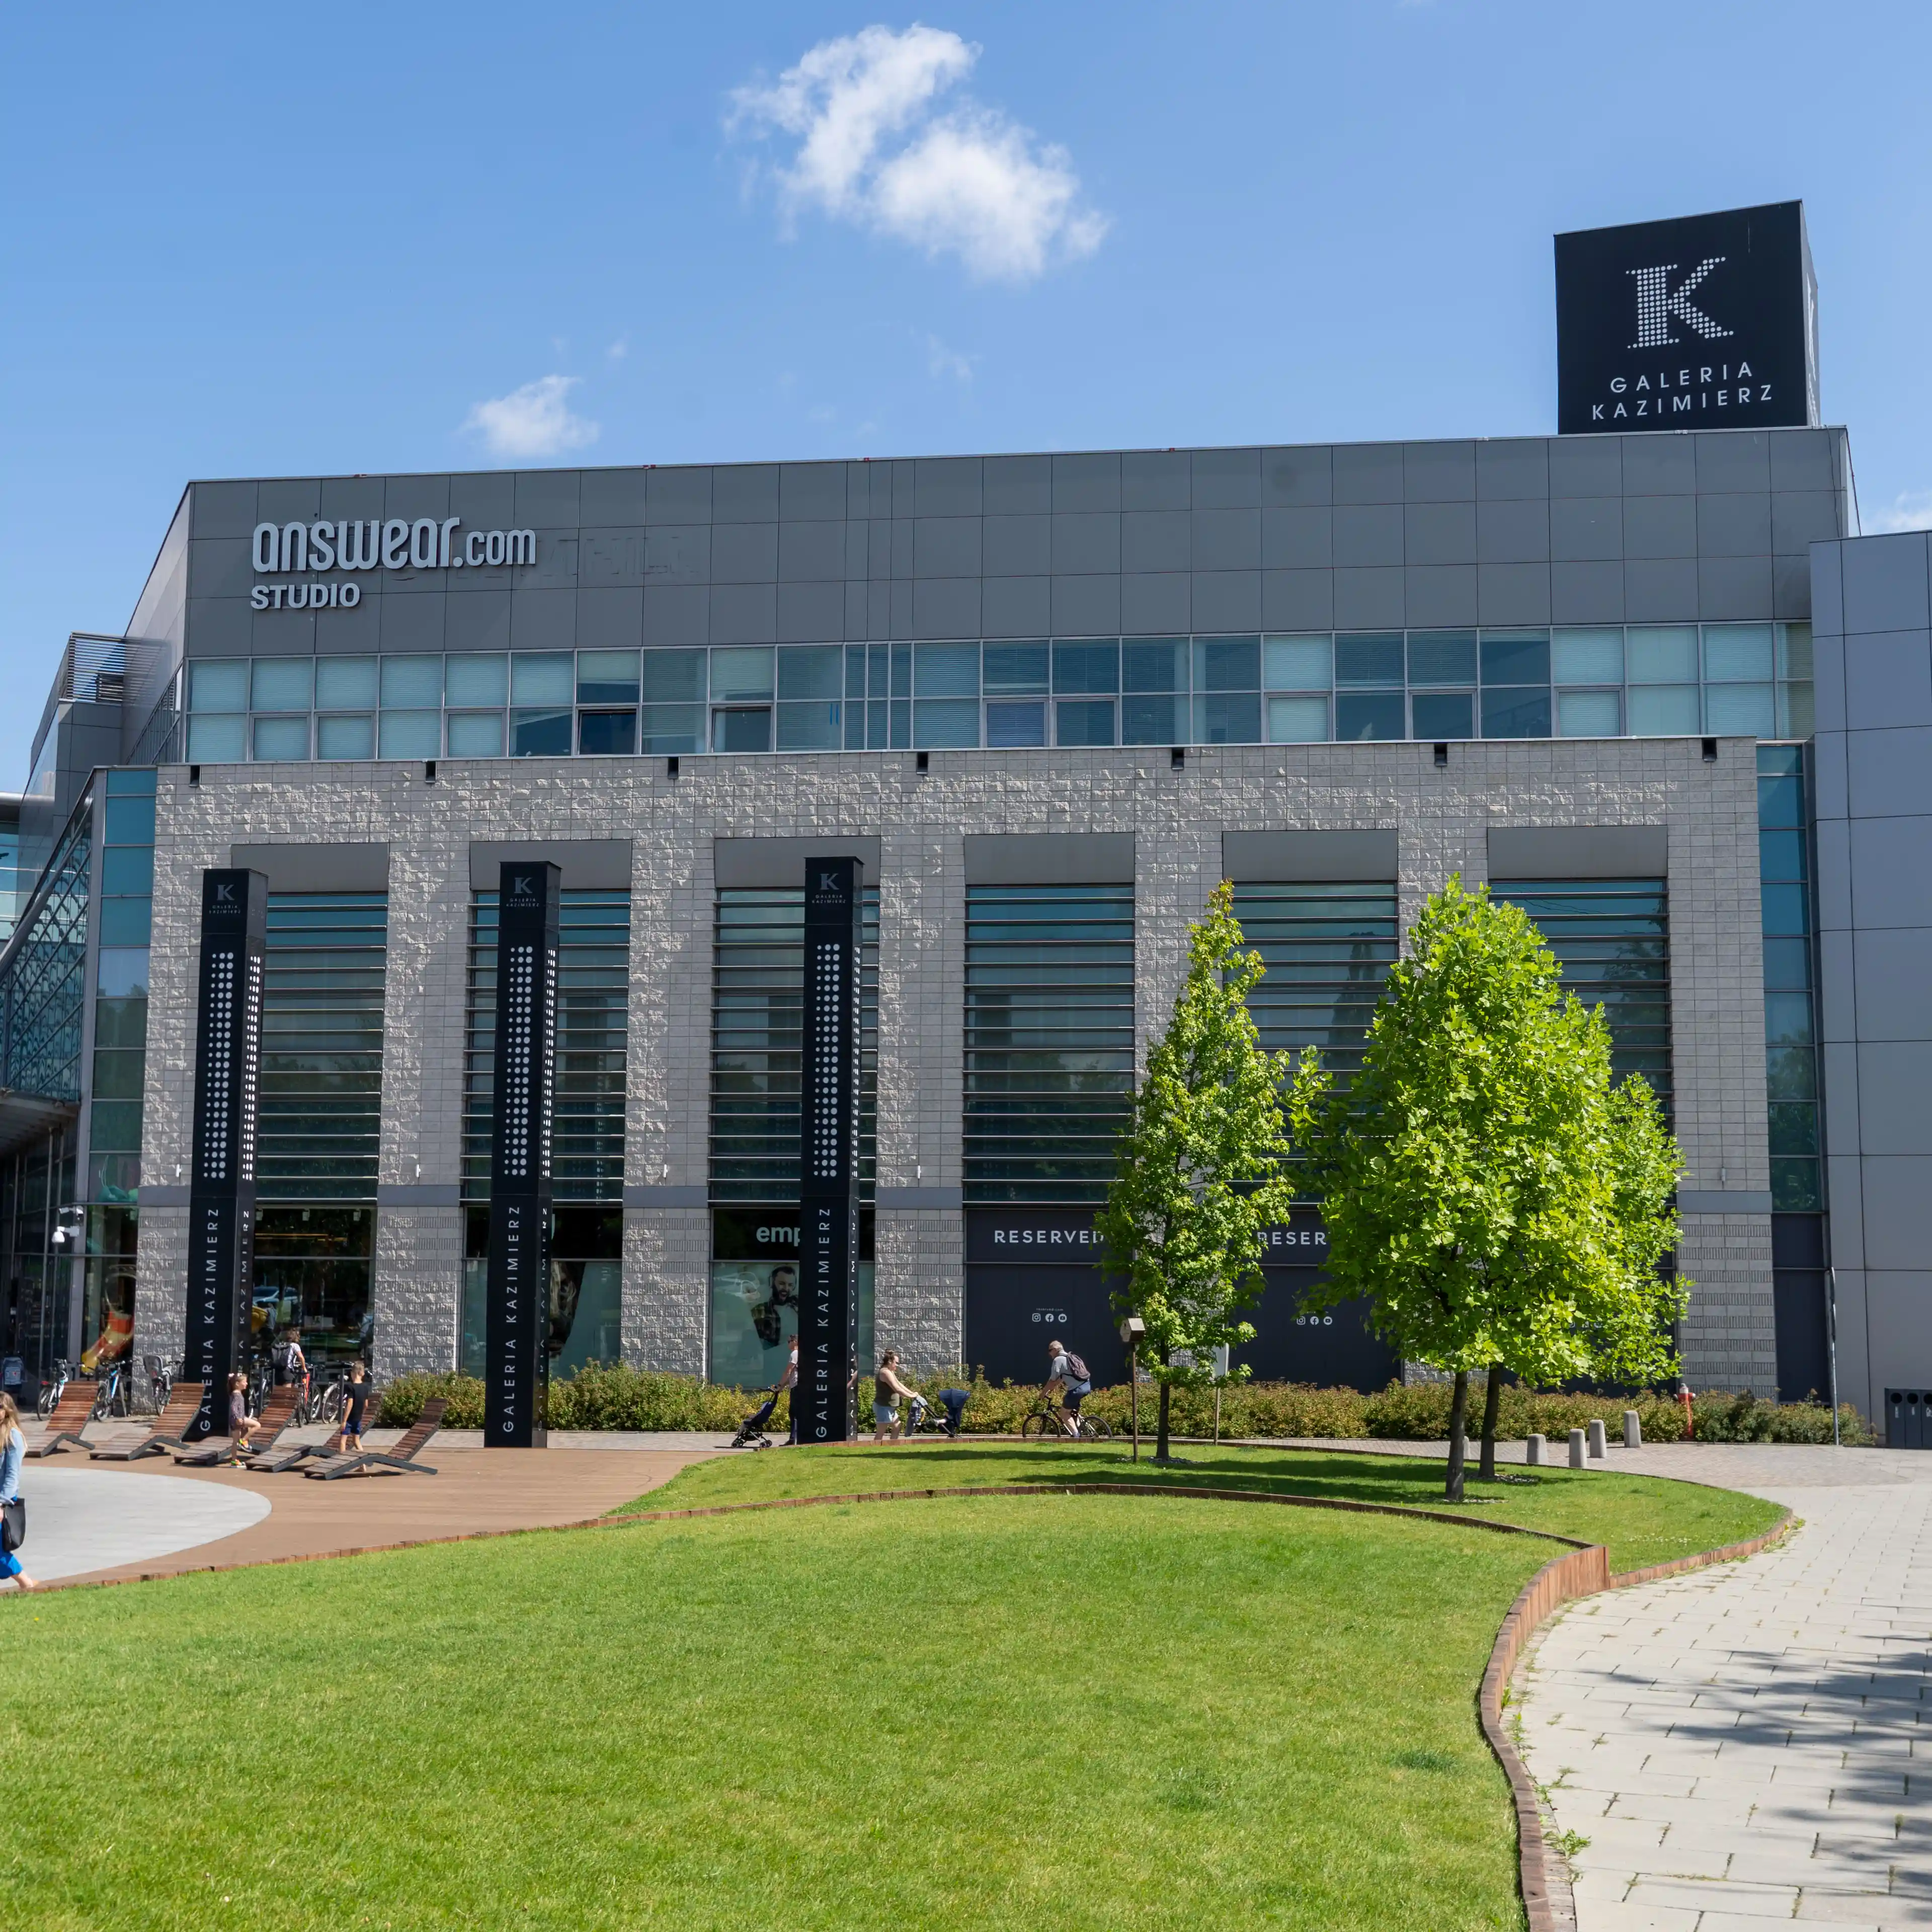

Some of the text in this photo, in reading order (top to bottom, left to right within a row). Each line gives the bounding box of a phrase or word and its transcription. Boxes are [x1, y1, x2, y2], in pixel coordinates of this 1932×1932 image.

[1626, 257, 1734, 349] K
[1610, 362, 1752, 393] GALERIA
[1592, 384, 1772, 420] KAZIMIERZ
[252, 517, 536, 573] answear.com
[250, 583, 360, 609] STUDIO
[216, 884, 235, 901] K
[514, 877, 533, 894] K
[820, 873, 840, 890] K
[756, 1227, 800, 1247] emp
[994, 1230, 1104, 1243] RESERVED
[1257, 1232, 1331, 1245] RESER
[200, 1209, 219, 1431] GALERIA KAZIMIERZ
[503, 1206, 520, 1432] GALERIA KAZIMIERZ
[816, 1209, 831, 1438] GALERIA KAZIMIERZ
